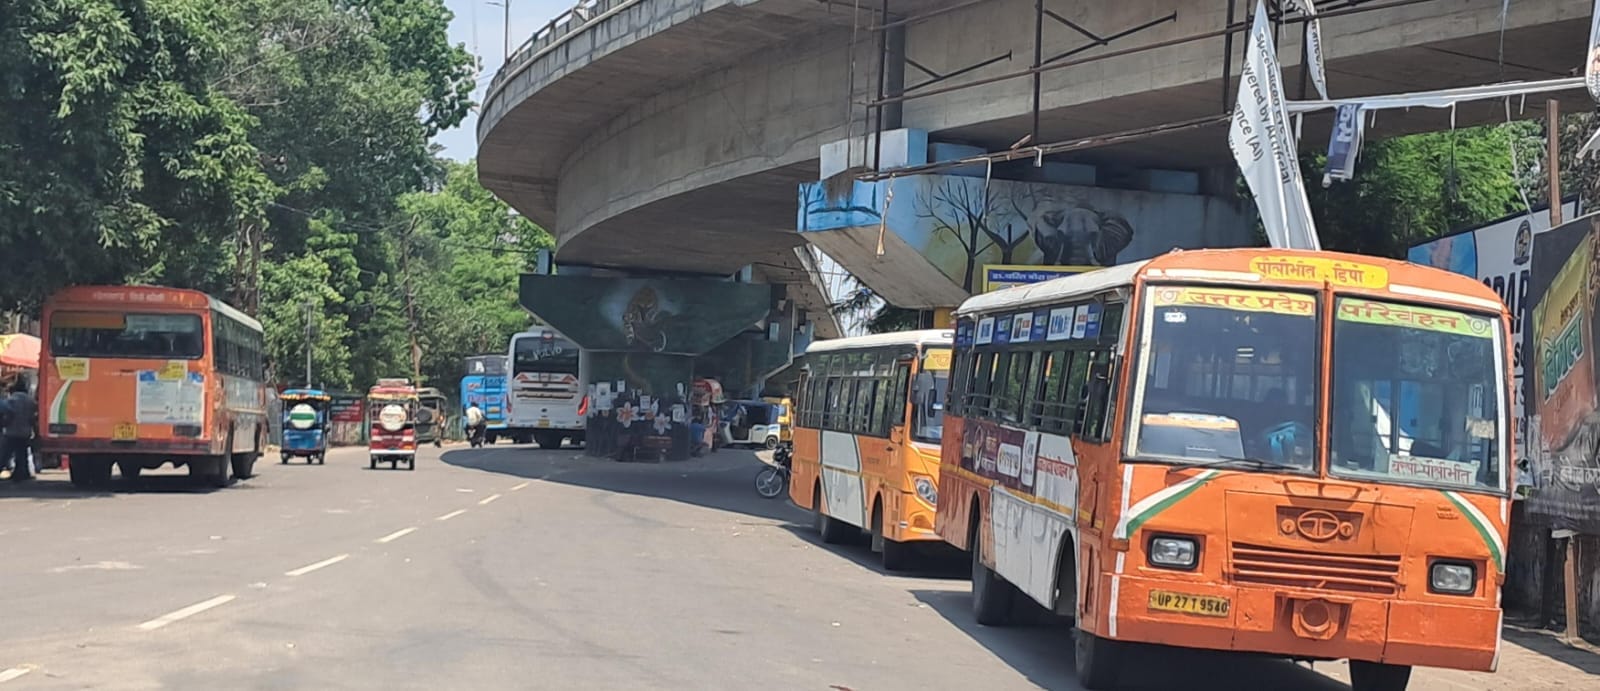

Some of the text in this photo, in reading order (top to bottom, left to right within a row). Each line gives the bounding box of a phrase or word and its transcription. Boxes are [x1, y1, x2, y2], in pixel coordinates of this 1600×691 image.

[1243, 61, 1266, 105] wered
[1259, 104, 1270, 122] by
[1235, 103, 1252, 135] ence
[1256, 258, 1316, 279] पीलीभीत
[1187, 291, 1314, 313] उत्तर प्रदेश
[1340, 301, 1461, 329] परिवहन
[1157, 593, 1171, 608] UP
[1174, 595, 1188, 609] 27
[1191, 598, 1197, 610] T
[1199, 598, 1228, 614] 9540
